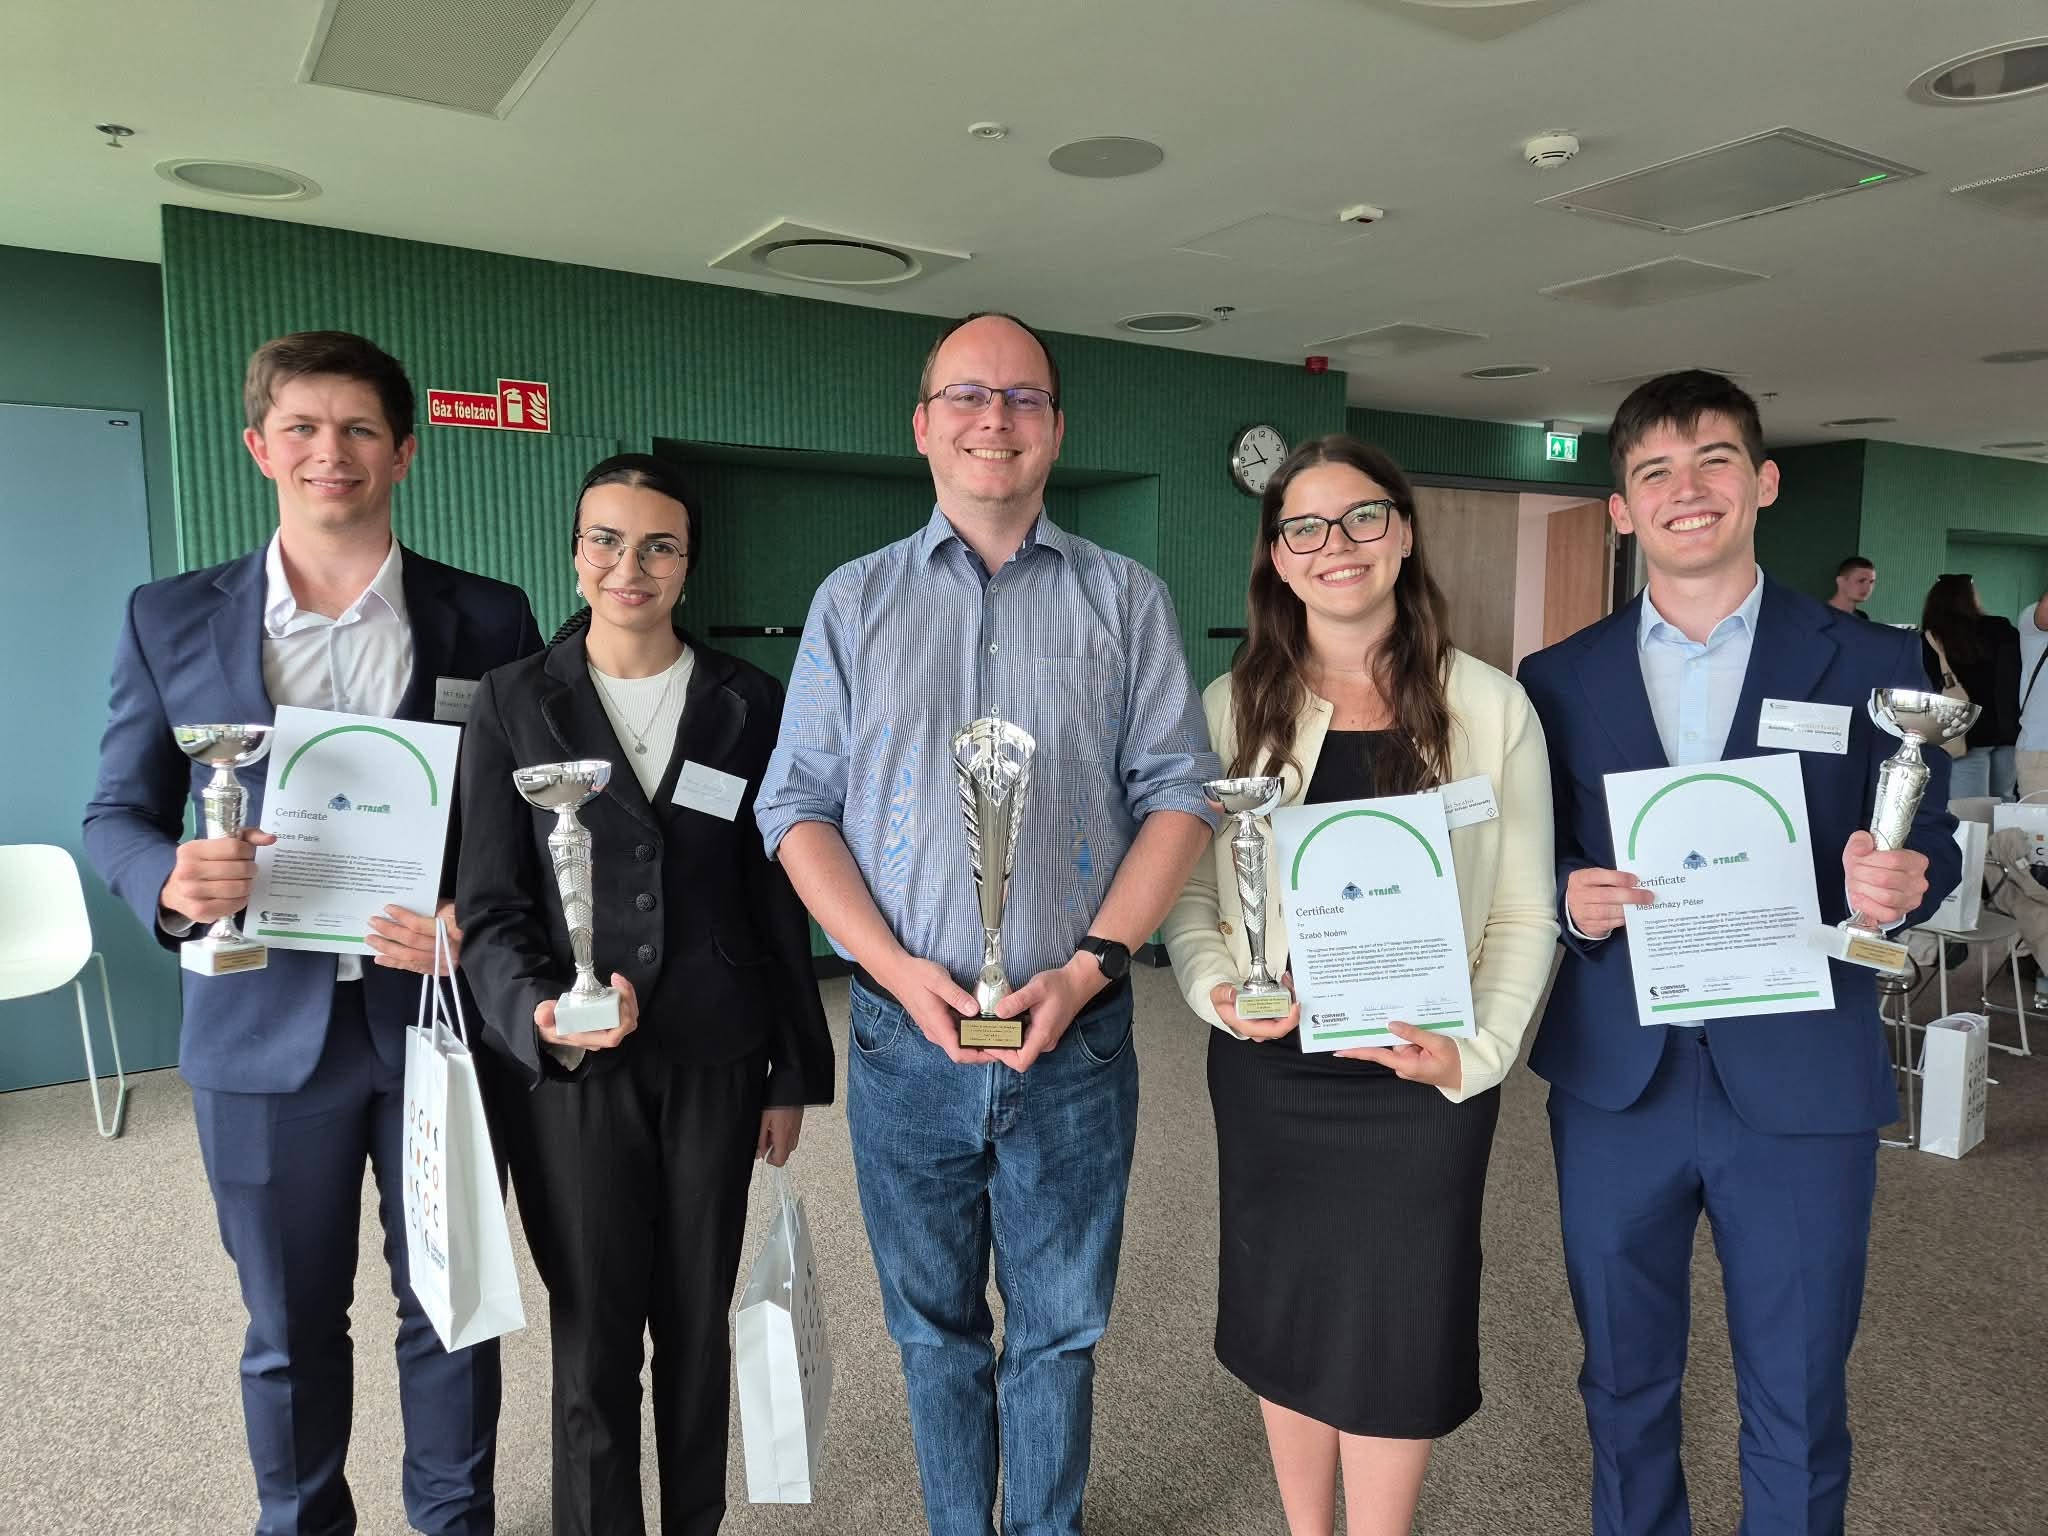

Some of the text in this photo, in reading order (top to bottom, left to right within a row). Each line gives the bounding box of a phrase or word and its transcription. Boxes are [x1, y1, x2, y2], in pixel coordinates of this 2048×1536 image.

[432, 399, 496, 420] Gáz főelzáró
[275, 808, 328, 821] Certificate
[1295, 905, 1345, 917] Certificate
[1299, 932, 1322, 940] Szabó
